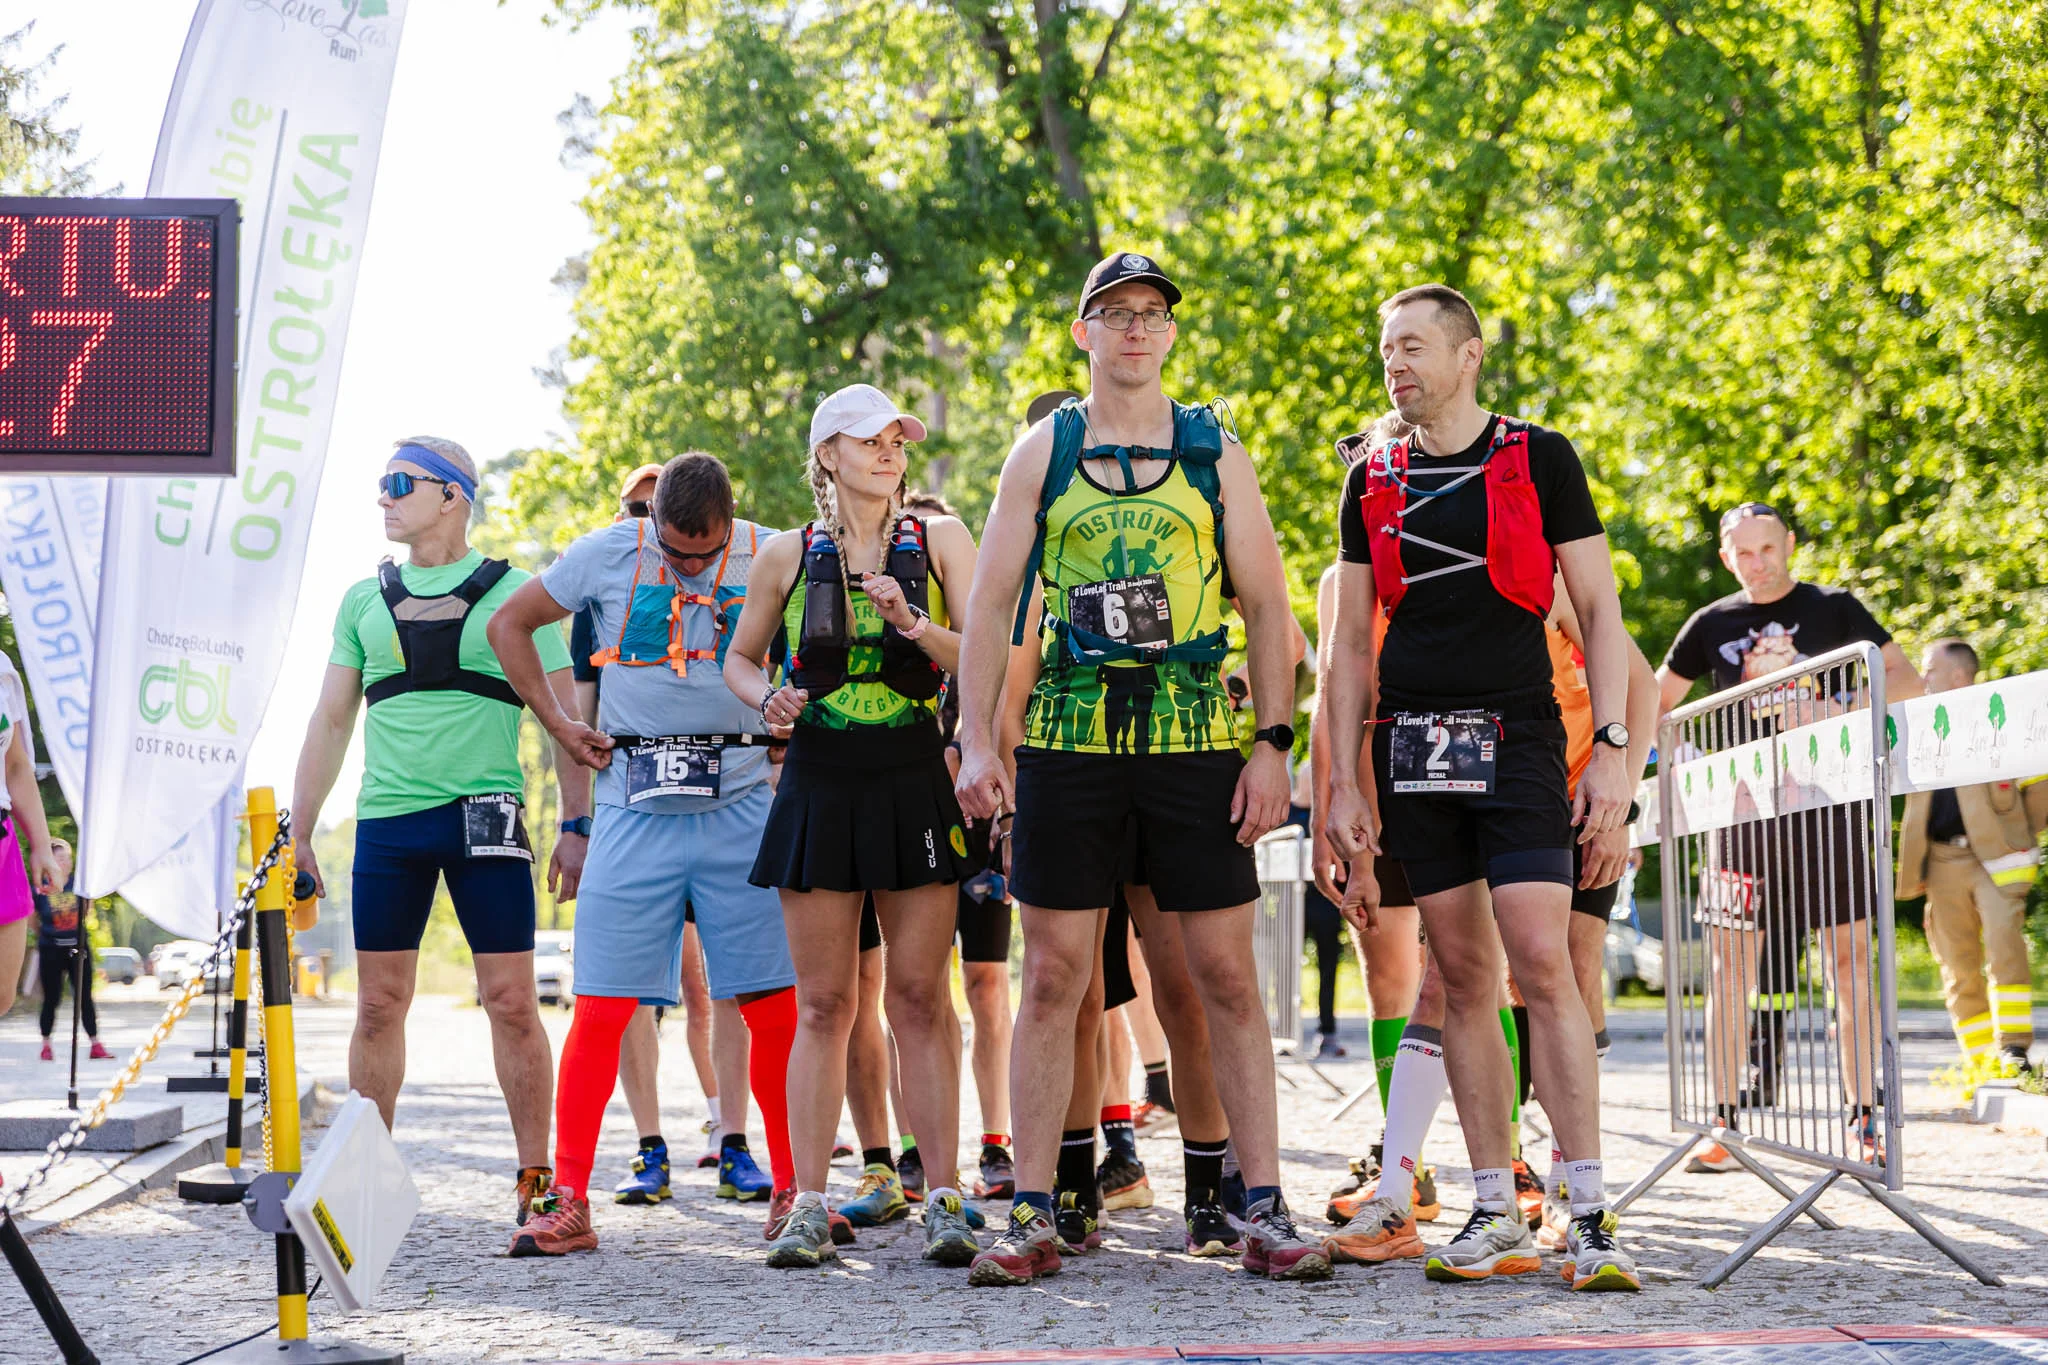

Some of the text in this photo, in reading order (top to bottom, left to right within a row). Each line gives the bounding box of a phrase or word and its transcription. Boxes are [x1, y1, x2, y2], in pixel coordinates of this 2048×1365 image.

[329, 38, 358, 63] Run
[229, 132, 360, 562] OSTROŁĘKA
[1076, 508, 1179, 542] OSTRÓW
[1108, 580, 1127, 592] Trail
[1103, 593, 1129, 637] 6
[147, 627, 245, 662] ChodzęBoLubię
[838, 693, 900, 714] BIEGA
[1433, 715, 1454, 725] Tail
[135, 736, 237, 764] OSTROŁĘKA
[1426, 727, 1450, 770] 2
[653, 750, 690, 782] 15
[505, 793, 519, 804] Tra
[500, 803, 516, 839] 7
